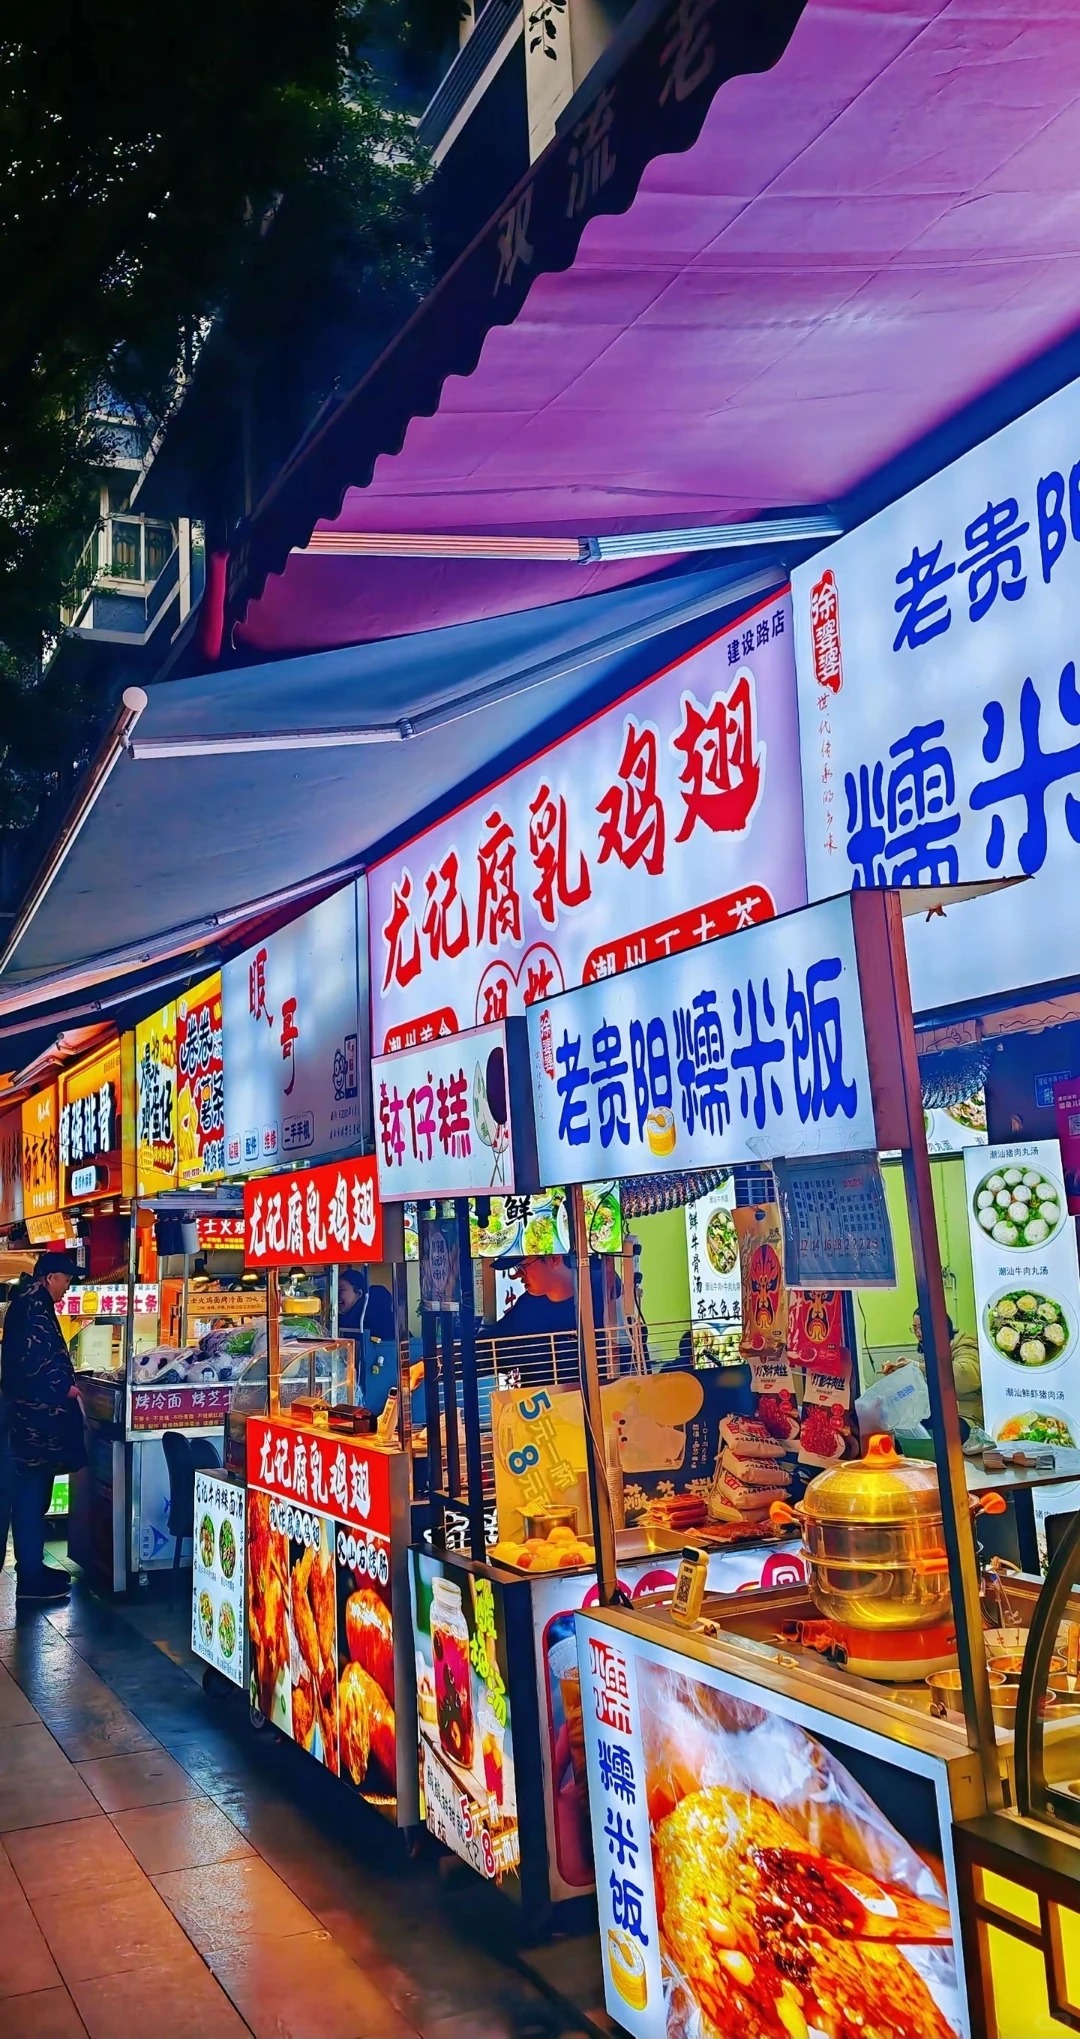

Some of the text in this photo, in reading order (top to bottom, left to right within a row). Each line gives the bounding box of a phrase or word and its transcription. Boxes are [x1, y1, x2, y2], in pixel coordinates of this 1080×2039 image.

[727, 609, 785, 667] 建设路店
[811, 583, 841, 684] 徐婆婆
[383, 677, 761, 991] 尤记腐乳鸡翅
[249, 947, 300, 1096] 眼哥
[556, 957, 858, 1149] 老贵阳糯米饭
[284, 1119, 311, 1144] 二手手机
[379, 1068, 472, 1167] 钵仔糕
[989, 1146, 1040, 1160] 潮汕猪肉丸汤
[248, 1171, 376, 1257] 尤记腐乳鸡翅
[187, 1295, 244, 1305] 士火鸡面烤冷面
[998, 1266, 1049, 1277] 潮汕牛肉丸汤
[135, 1392, 183, 1411] 烤冷面
[1005, 1387, 1065, 1400] 潮汕鲜虾猪肉汤
[259, 1428, 372, 1520] 尤记腐乳鸡翅
[338, 1532, 389, 1585] 火山石烤肠
[597, 1738, 649, 1947] 糯米饭
